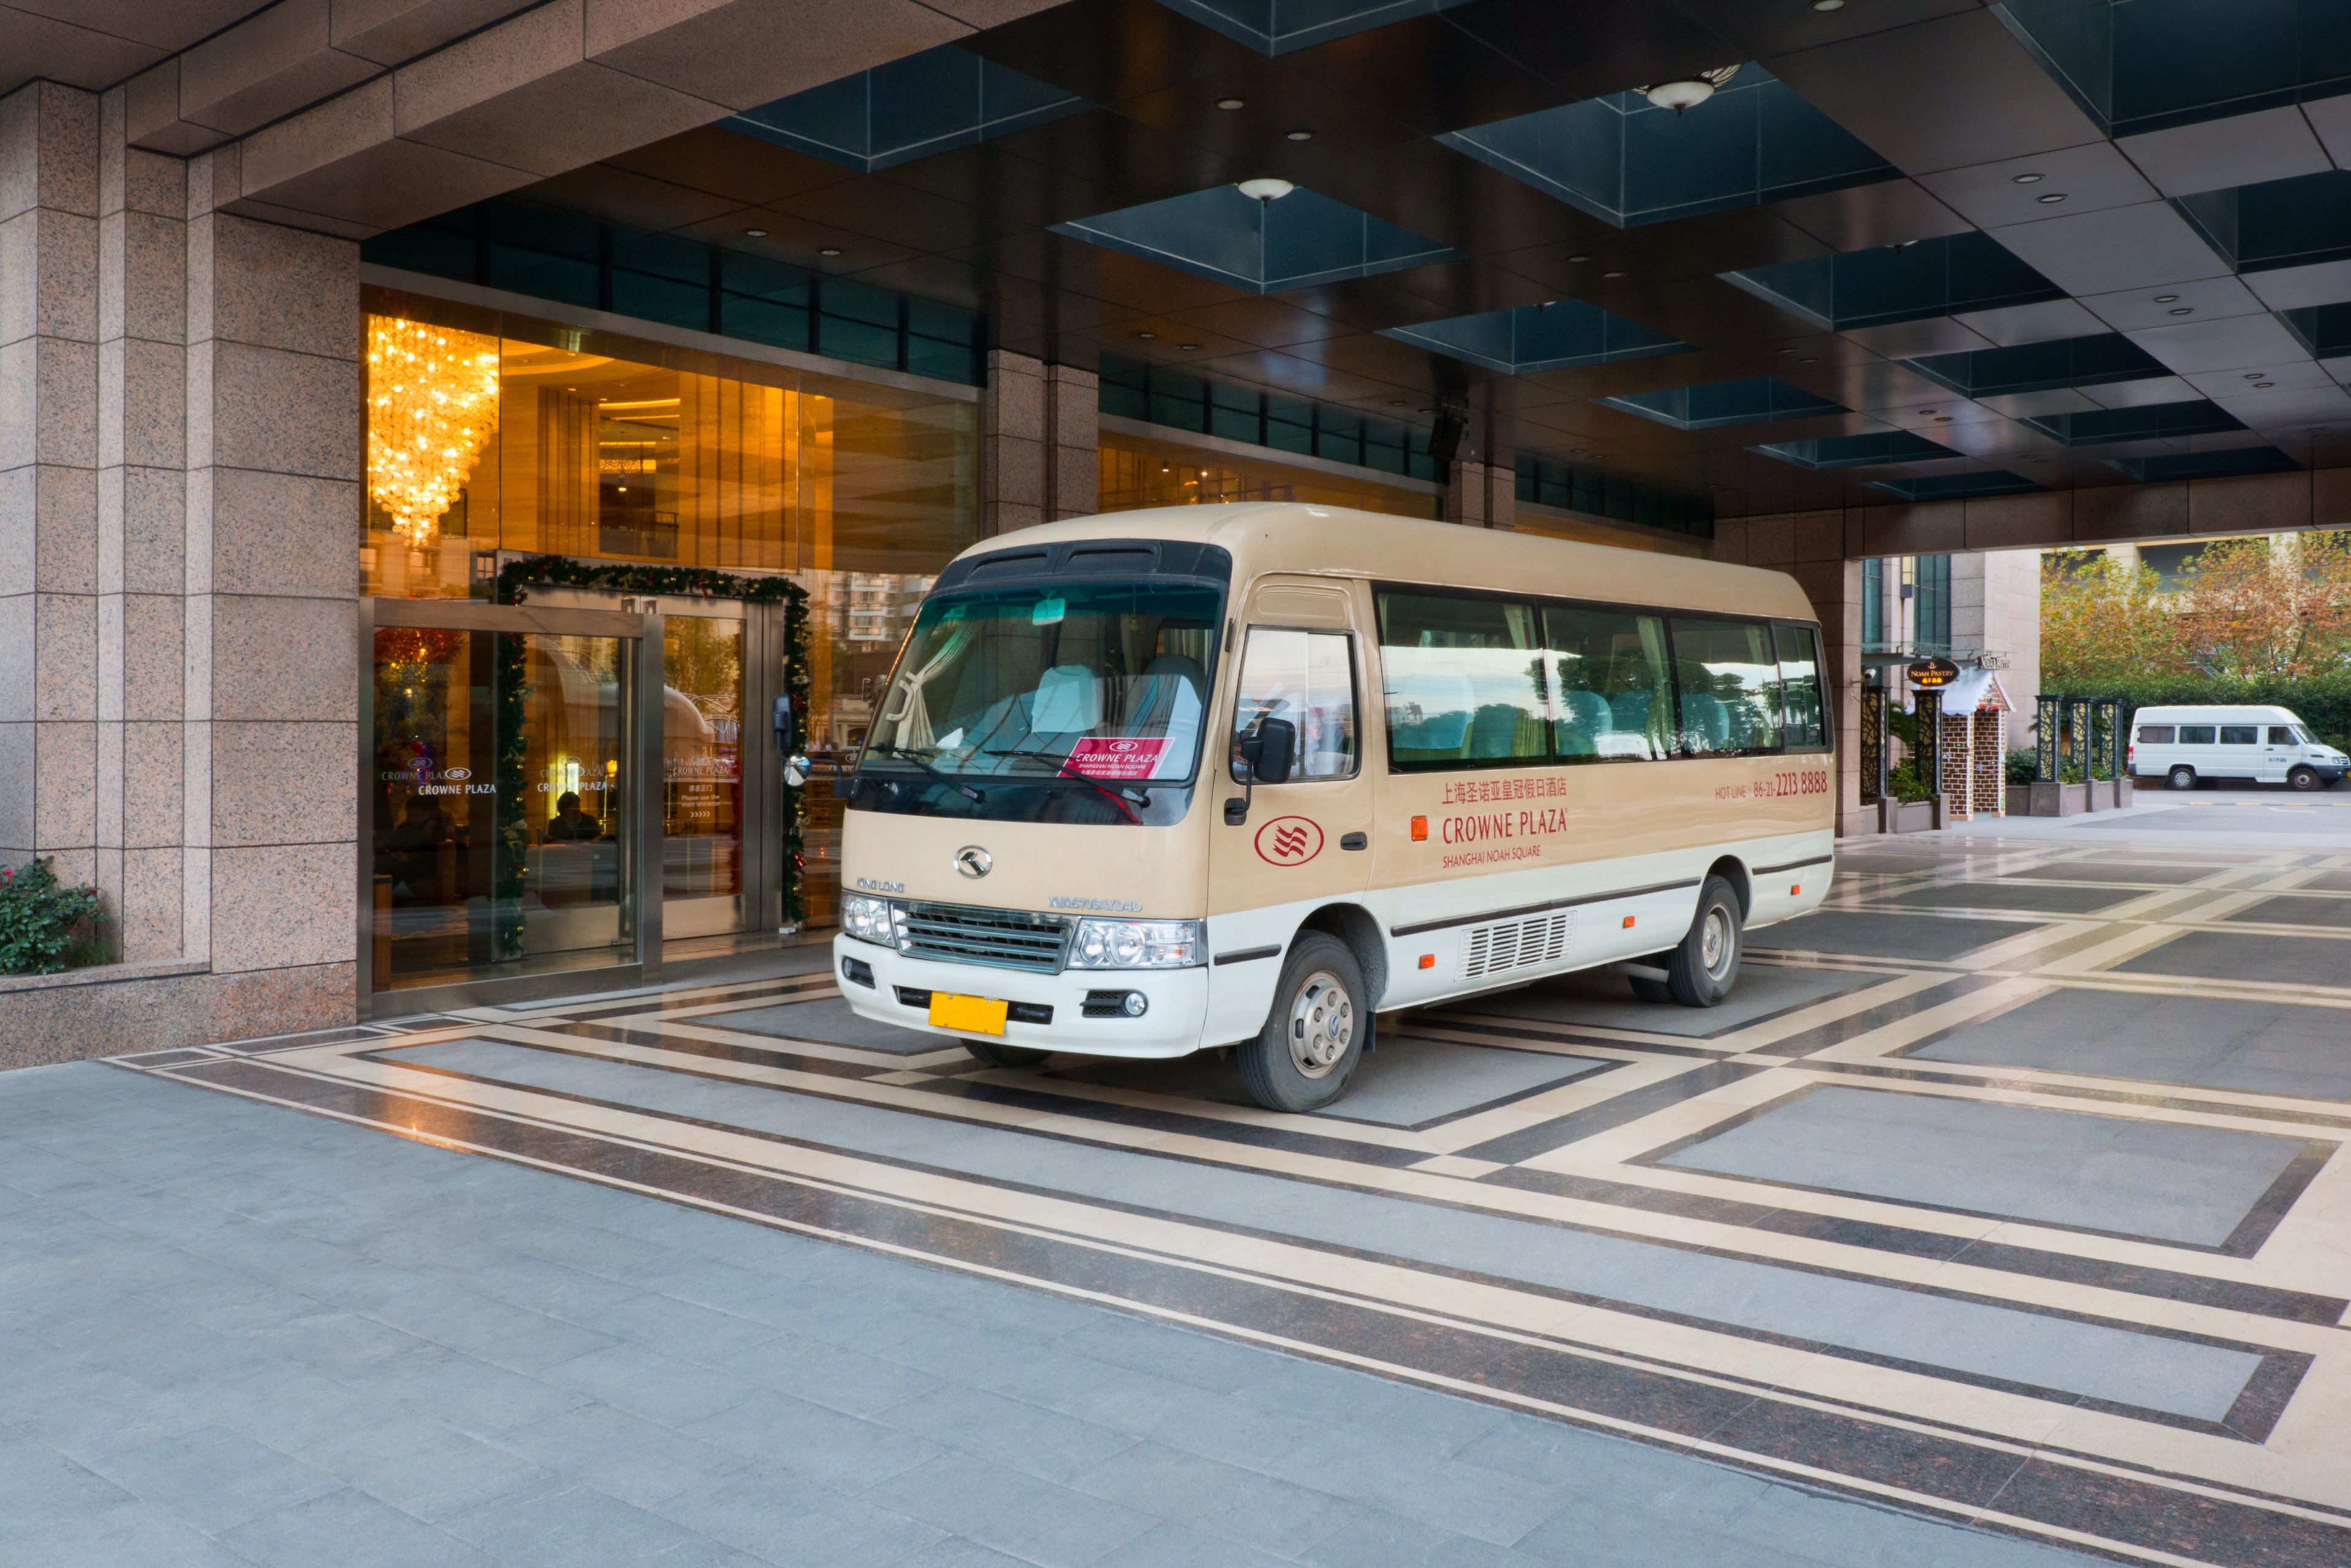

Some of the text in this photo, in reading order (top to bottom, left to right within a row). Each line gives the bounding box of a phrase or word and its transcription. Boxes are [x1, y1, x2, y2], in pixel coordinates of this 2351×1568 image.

[1076, 754, 1158, 763] CROWNE PLAZA
[381, 770, 454, 781] CROWNE PLAZ
[706, 766, 729, 775] PLAZA
[418, 784, 497, 795] CROWNE PLAZA
[580, 782, 607, 791] PLAZA
[1442, 776, 1567, 805] 上海圣诺亚皇冠假日酒店
[1715, 787, 1731, 800] HOT
[1801, 771, 1828, 794] 8888
[1443, 808, 1567, 844] CROWNE PLAZA
[1443, 845, 1541, 868] SHANGHAI NOAH SQUARE
[857, 877, 904, 893] KING LONG
